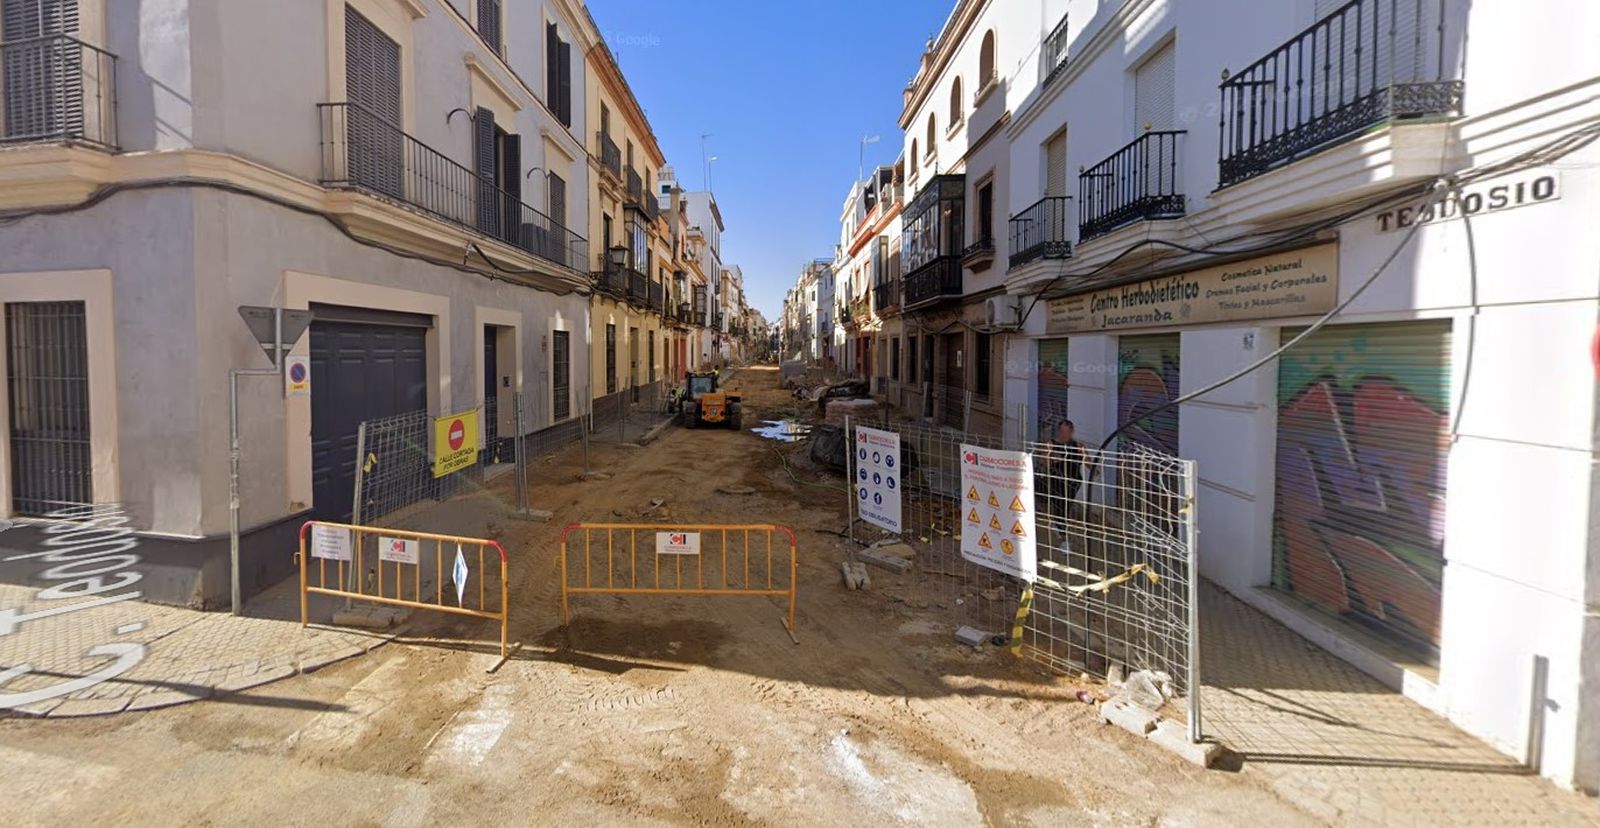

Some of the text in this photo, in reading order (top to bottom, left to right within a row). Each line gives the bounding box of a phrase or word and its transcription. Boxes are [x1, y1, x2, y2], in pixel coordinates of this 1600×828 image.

[1264, 259, 1302, 276] Natural
[1270, 273, 1328, 289] Corporales
[1090, 276, 1200, 314] Centro Herbodietético
[1101, 308, 1173, 328] Jacaranda
